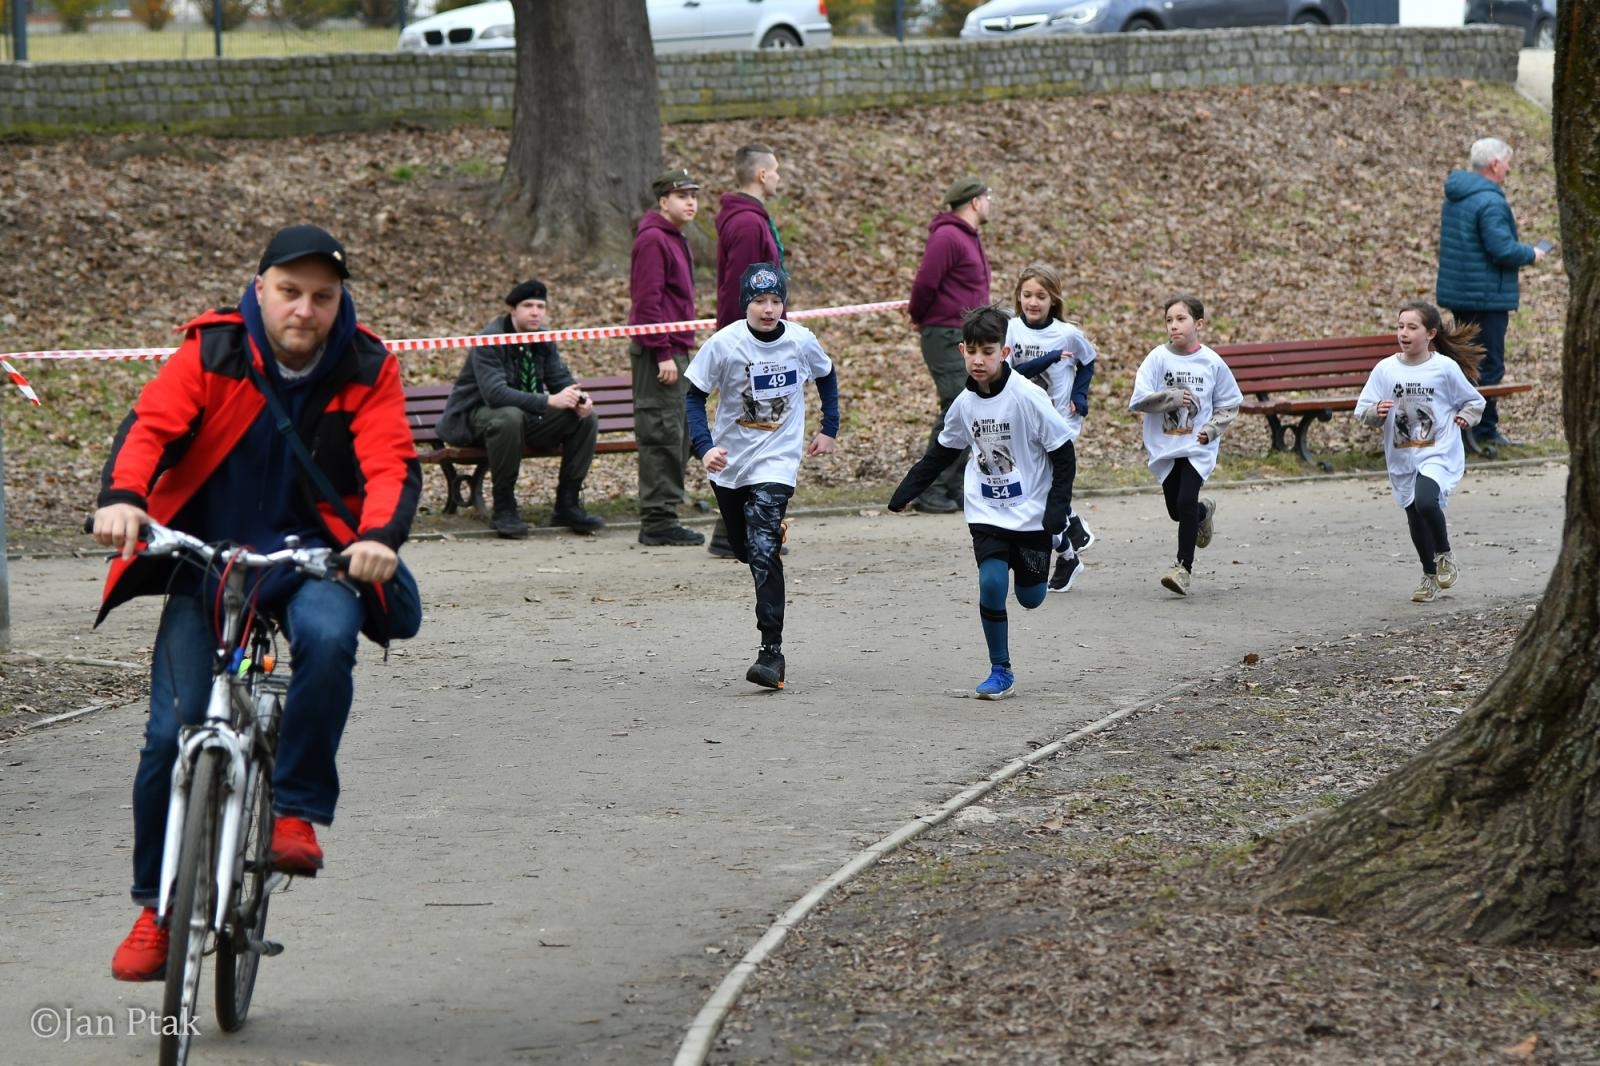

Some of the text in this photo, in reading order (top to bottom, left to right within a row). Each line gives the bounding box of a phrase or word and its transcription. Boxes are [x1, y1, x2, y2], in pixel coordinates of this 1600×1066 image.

[768, 374, 787, 387] 49
[1176, 376, 1204, 384] WILCZYM
[1405, 387, 1434, 395] WILCZYM
[981, 422, 1010, 433] WILCZYM
[991, 485, 1010, 499] 54
